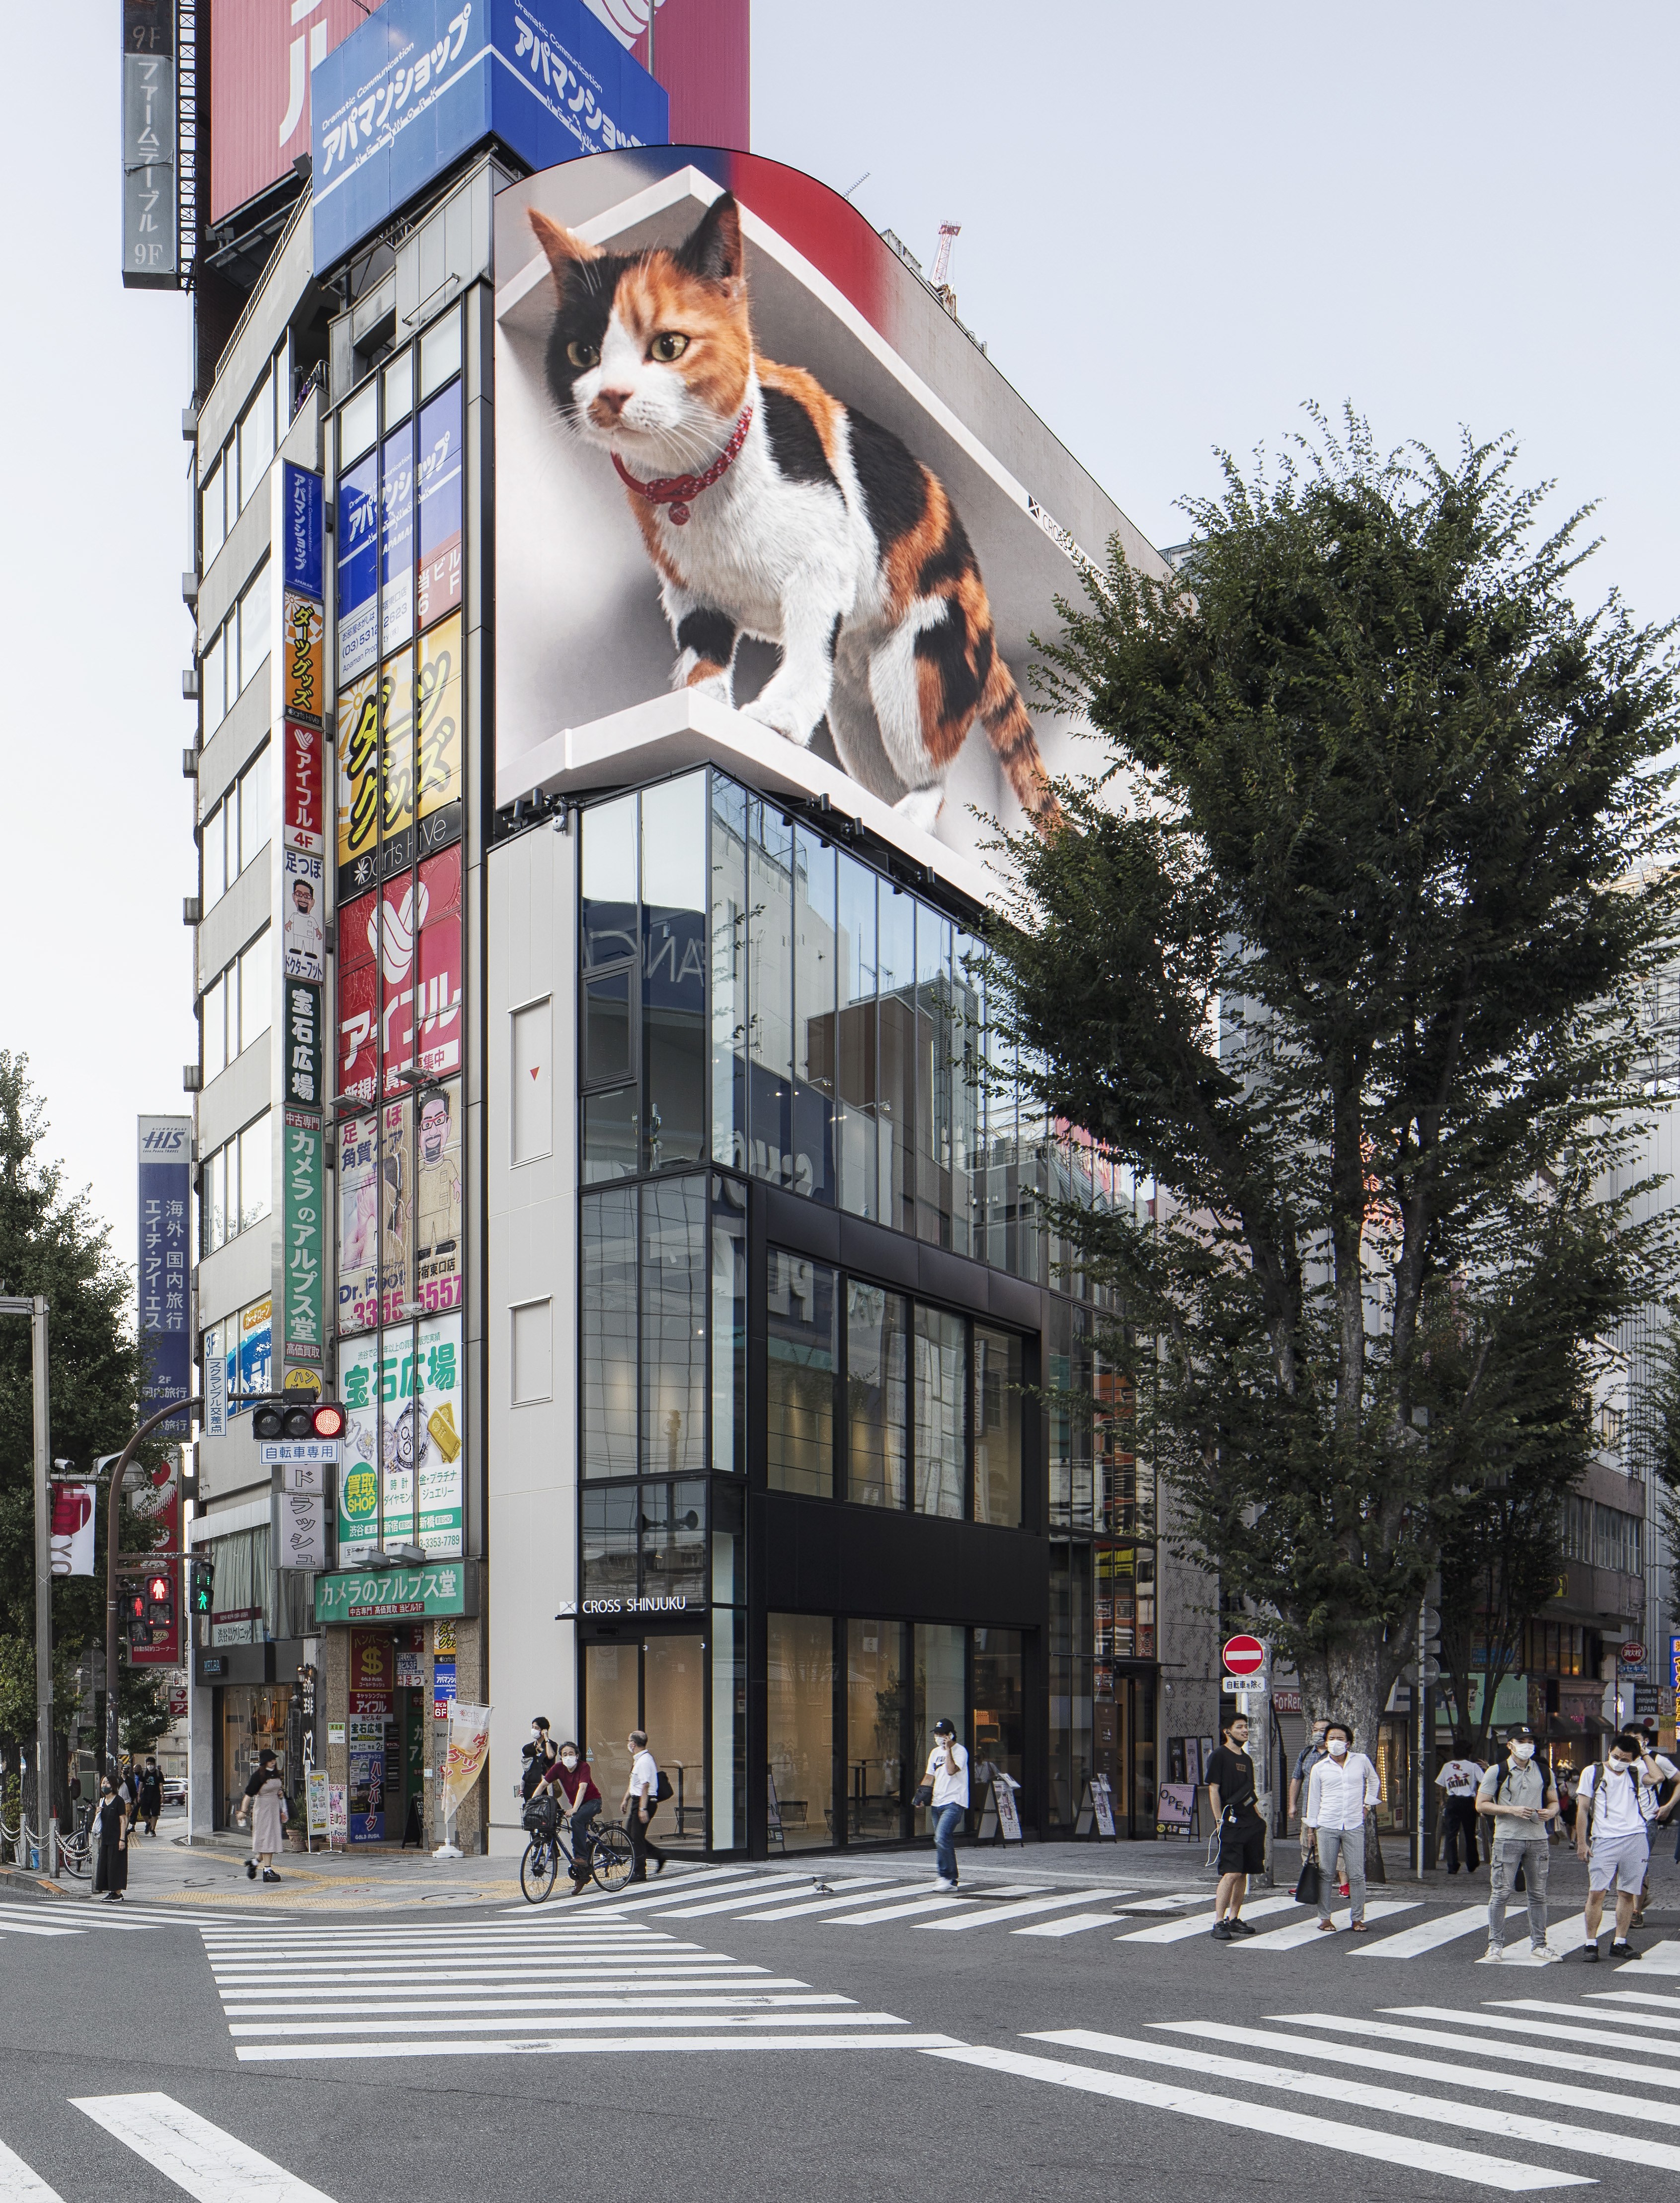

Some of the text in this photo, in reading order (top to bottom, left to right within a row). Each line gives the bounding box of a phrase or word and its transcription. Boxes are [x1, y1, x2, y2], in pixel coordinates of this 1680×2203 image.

[132, 25, 161, 49] 9F
[550, 33, 603, 94] Communication
[322, 42, 414, 131] Dramatic Communication
[322, 2, 472, 175] アパマンショップ
[138, 62, 160, 233] ファームテーブル
[134, 243, 163, 265] 9F
[294, 473, 306, 570] アパマンショップ
[294, 578, 313, 588] APAMAN
[342, 611, 375, 642] お部屋さがしは
[293, 606, 315, 710] ダーツグッズ
[342, 652, 364, 673] Apaman
[296, 749, 313, 827] アイフル
[294, 831, 314, 848] 4F
[285, 851, 322, 879] 足つぼ
[285, 954, 322, 980] ドクターフット
[342, 972, 462, 1071] アイフル
[292, 988, 315, 1101] 宝石広場
[286, 1111, 320, 1131] 中古専門
[342, 1102, 403, 1146] 足つぼ
[290, 1131, 318, 1342] カメラのアルプス堂
[145, 1199, 162, 1329] エイチ・アイ・エス
[165, 1200, 184, 1329] 海外・国内旅行
[206, 1332, 216, 1358] 3F
[286, 1342, 320, 1359] 高価買取
[345, 1342, 456, 1410] 宝石広場
[210, 1361, 222, 1433] スクランブル交差点
[266, 1445, 333, 1460] 自転車専用
[348, 1472, 376, 1499] 買取
[422, 1486, 455, 1500] ジュエリー
[347, 1496, 376, 1513] SHOP
[349, 1524, 364, 1538] 渋谷
[383, 1520, 398, 1534] 新宿
[419, 1515, 435, 1529] 新橋
[320, 1569, 457, 1607] カメラのアルプス堂
[350, 1603, 423, 1616] 中古専門 高価買取 当ビル1F
[582, 1596, 686, 1614] CROSS SHINJUKU
[204, 1659, 220, 1672] MELBA
[1226, 1680, 1262, 1689] 自転車を除く
[356, 1701, 387, 1713] アイフル
[435, 1709, 447, 1717] 6F
[351, 1722, 383, 1734] 宝石広場
[365, 1761, 382, 1832] ハンバーグ
[1160, 1789, 1192, 1817] OPEN
